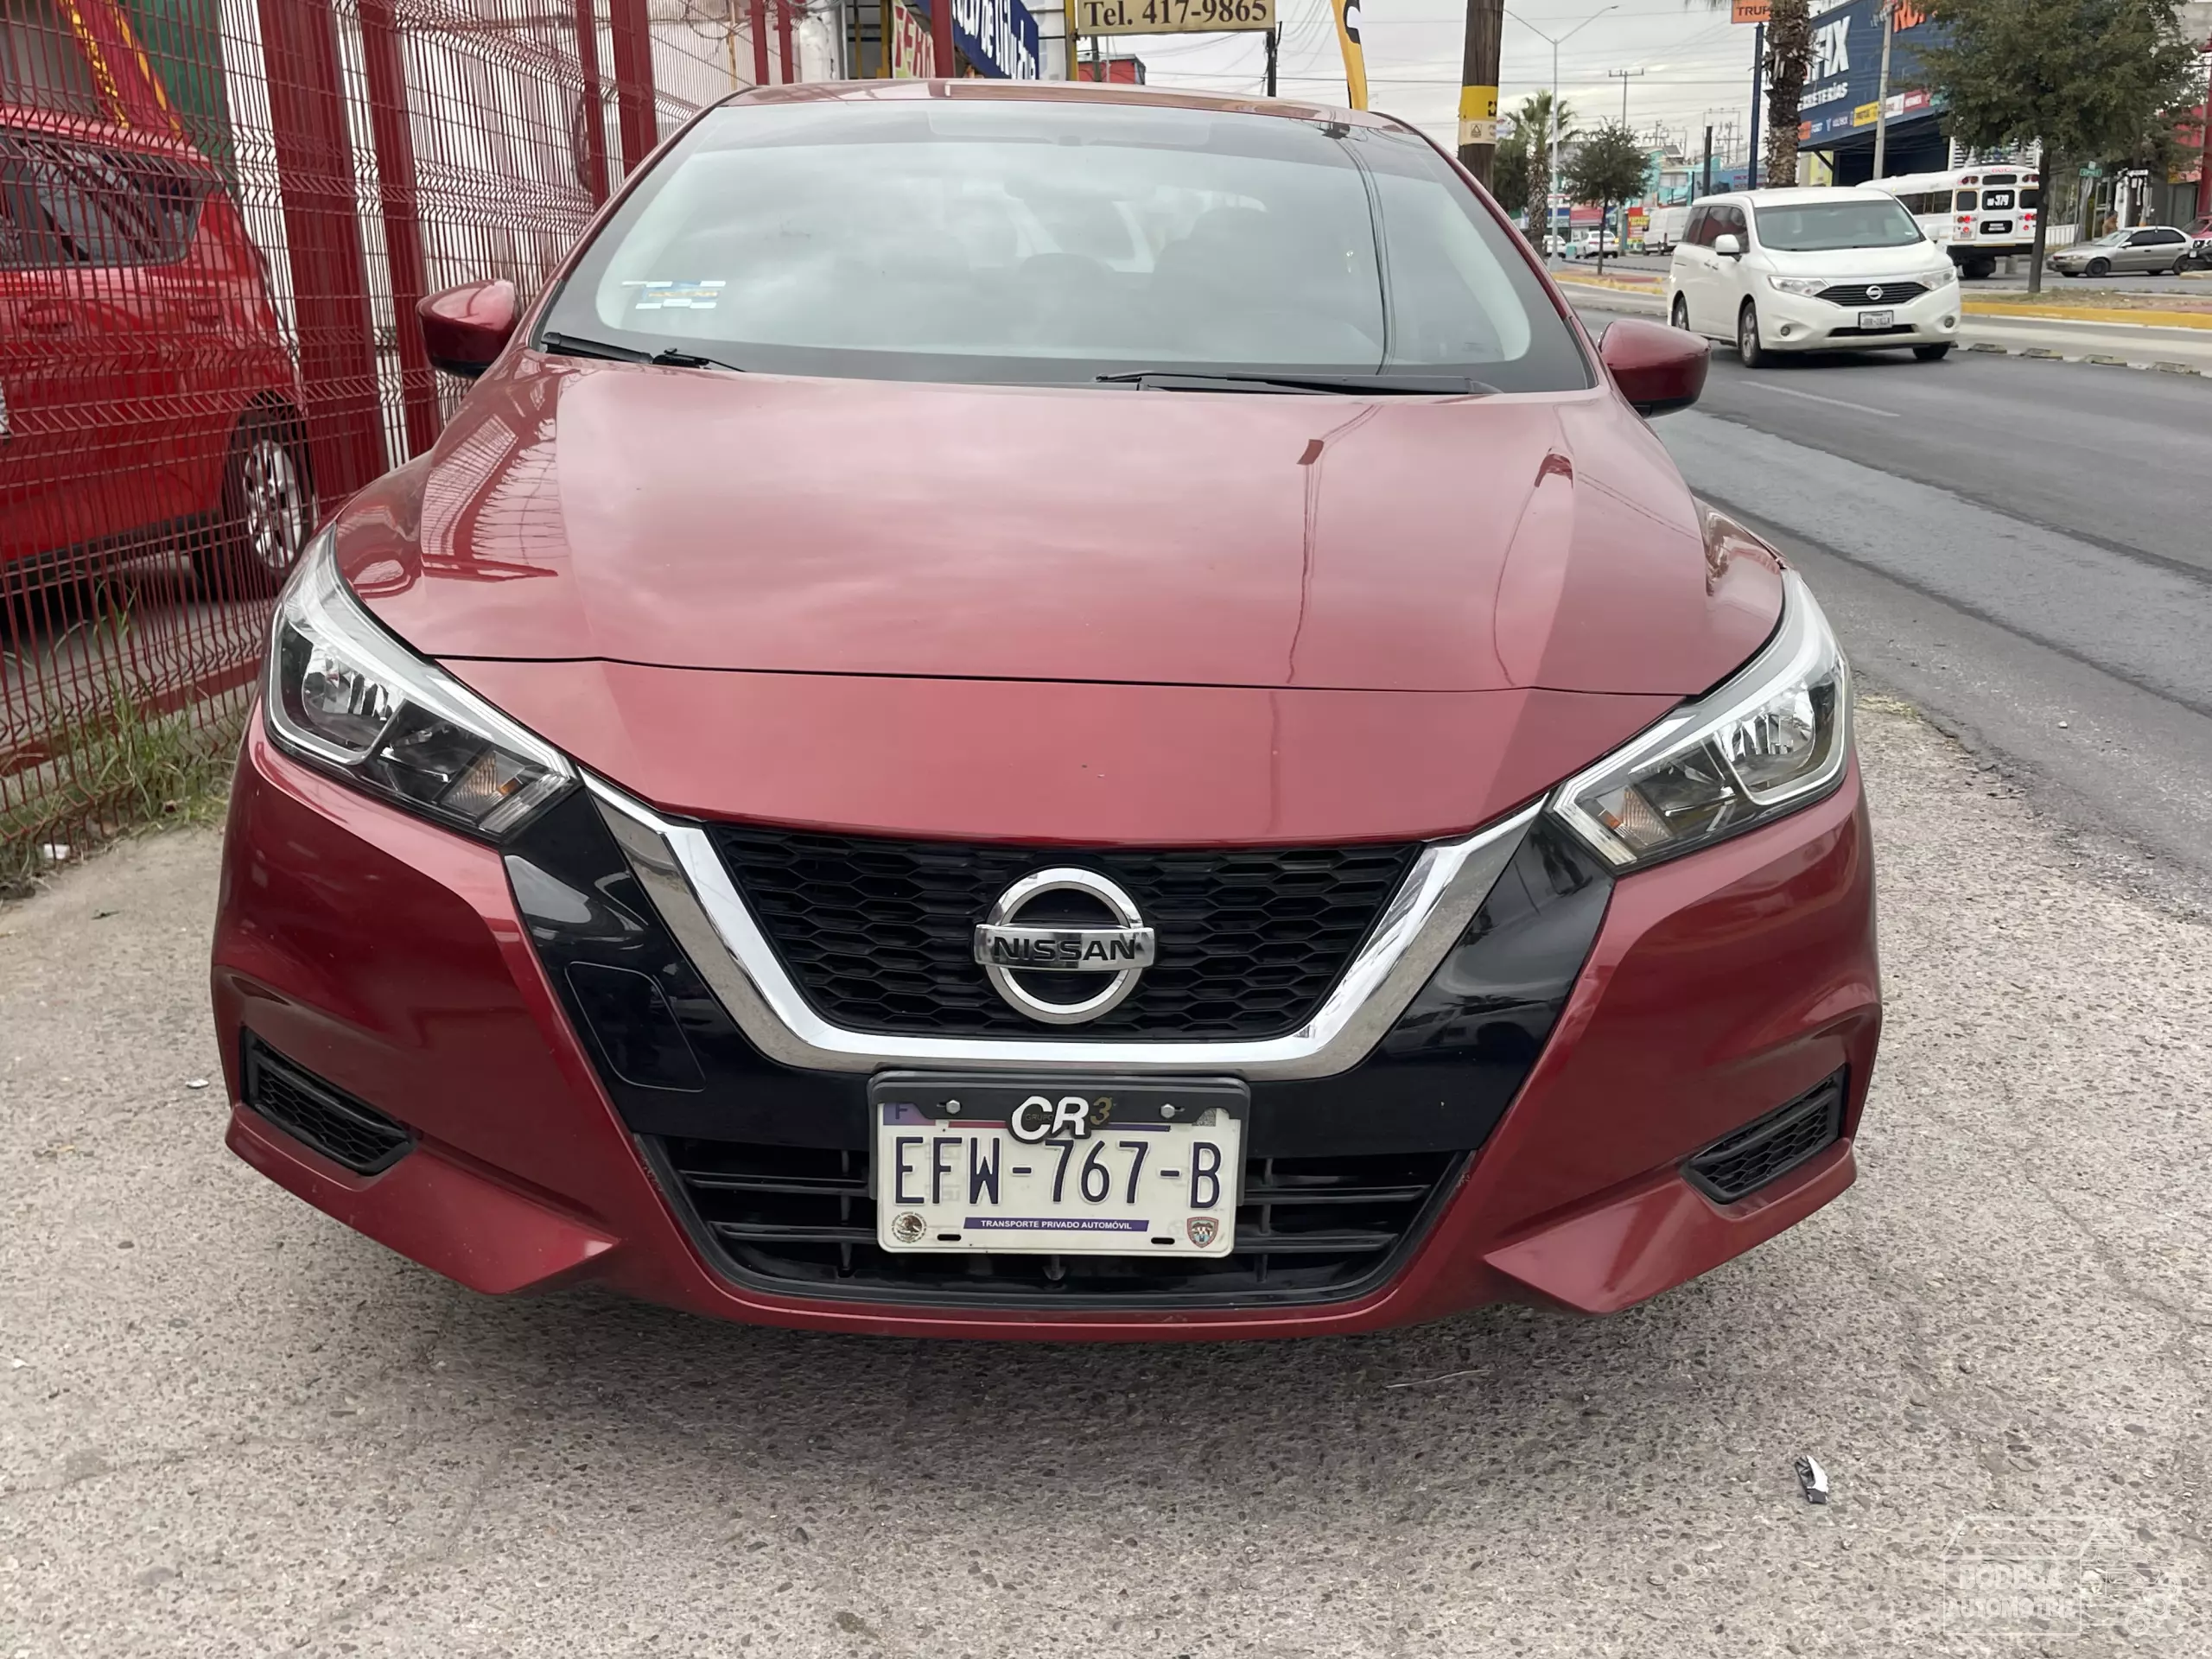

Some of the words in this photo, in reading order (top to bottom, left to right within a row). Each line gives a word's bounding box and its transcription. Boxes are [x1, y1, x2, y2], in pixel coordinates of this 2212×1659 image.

[1084, 1, 1133, 27] Tel.
[1142, 0, 1268, 24] 417-9865
[1803, 16, 1851, 86] FIX
[994, 937, 1135, 961] NISSAN
[895, 1136, 1223, 1209] EFW-767-B
[1041, 1220, 1080, 1229] PRIVADO
[1081, 1220, 1132, 1230] AUTOMÓVIL
